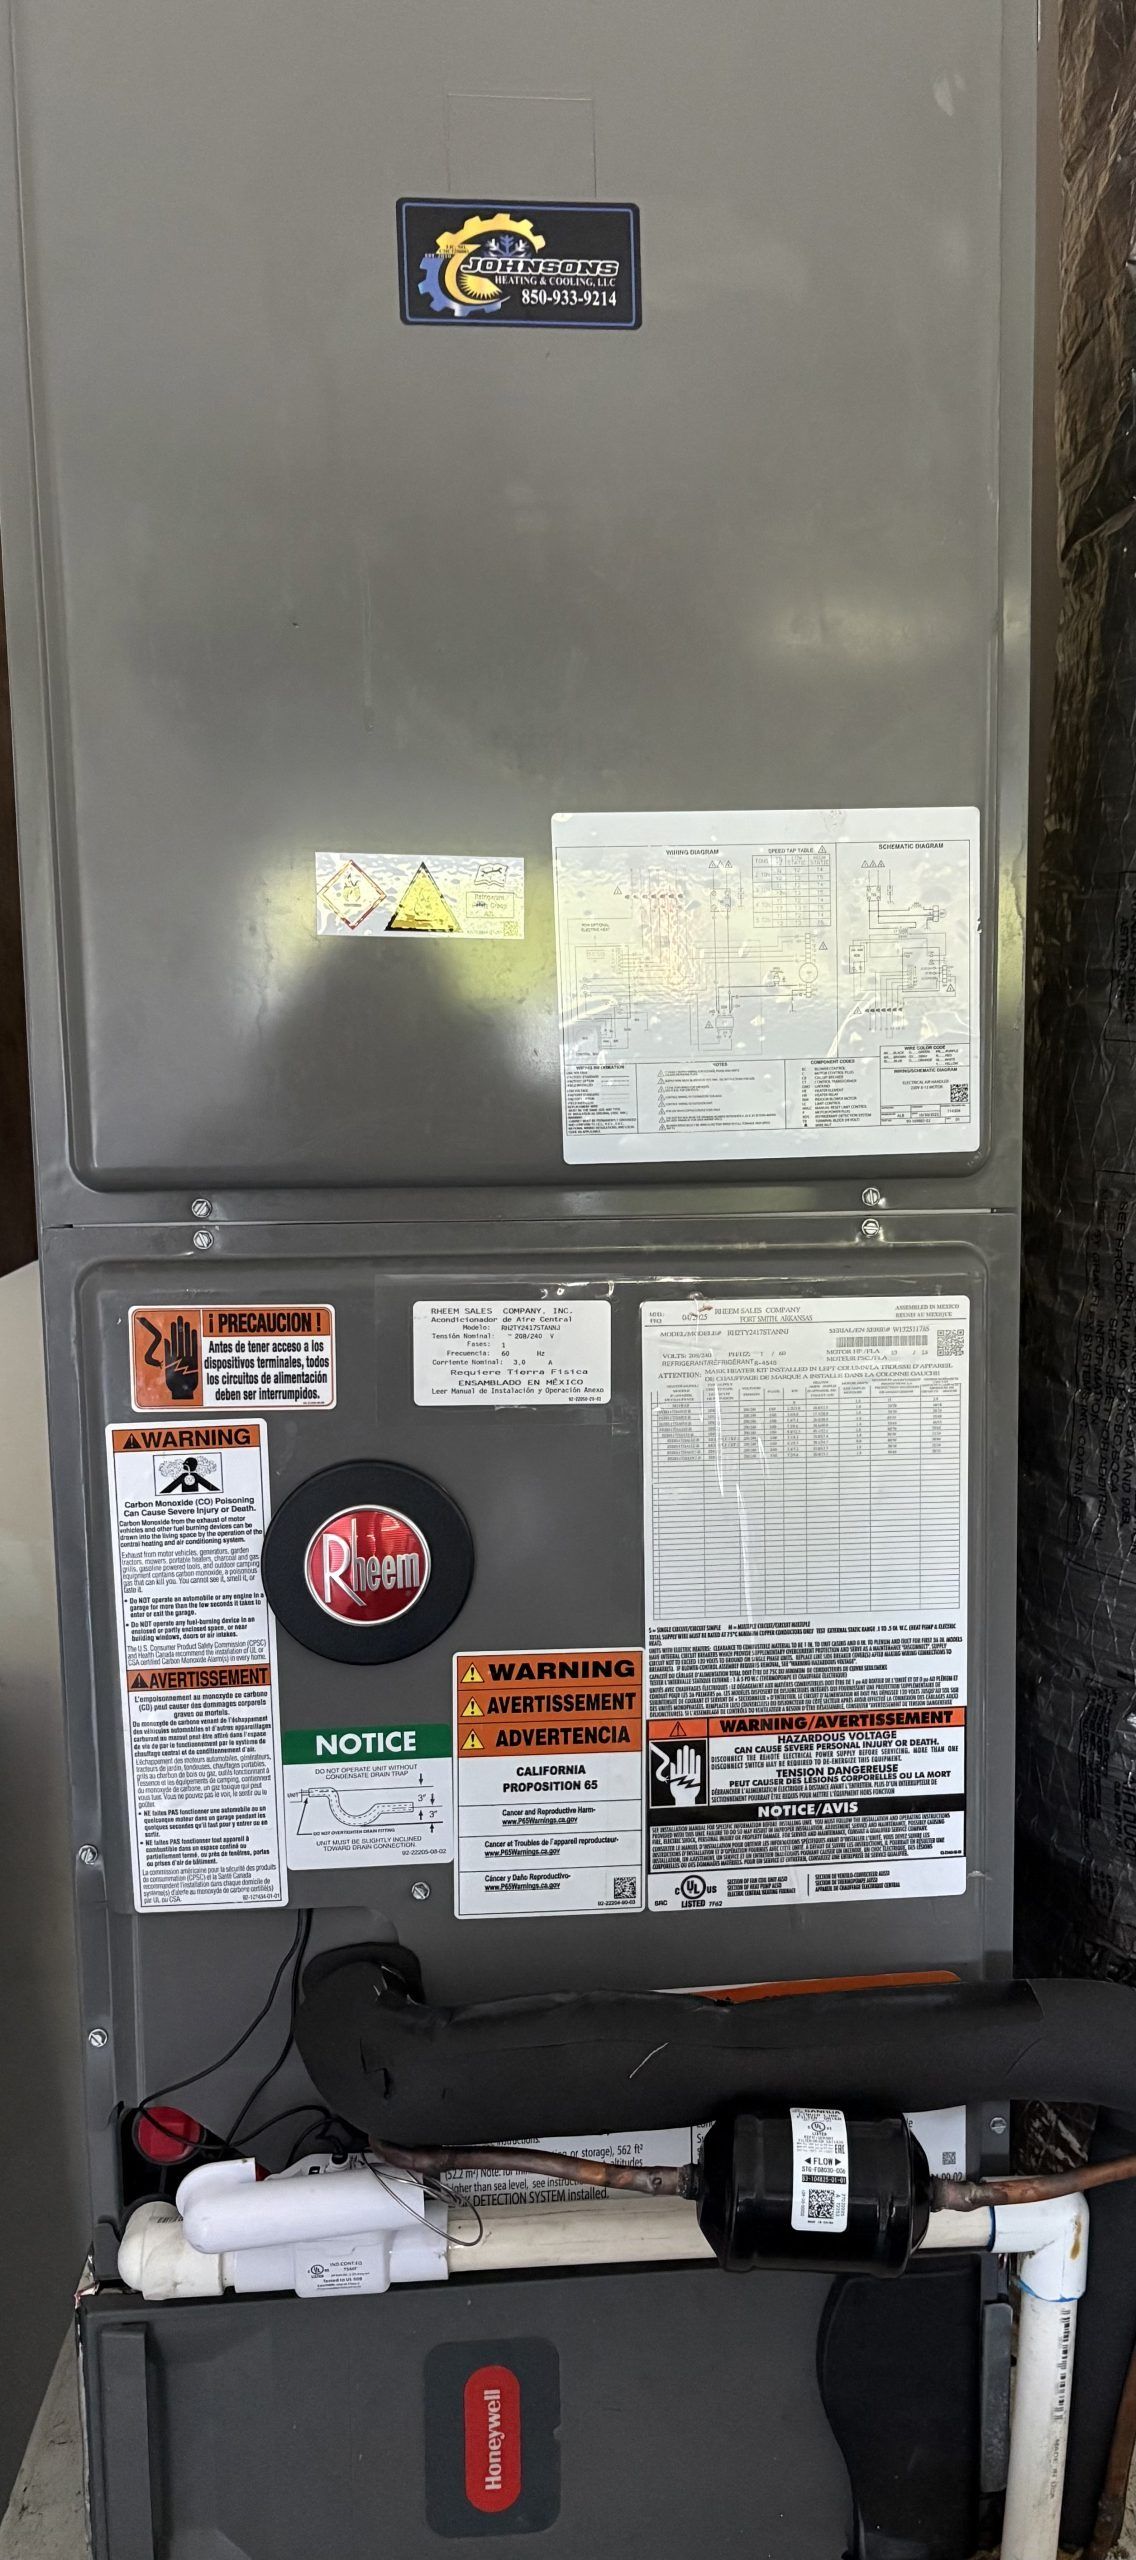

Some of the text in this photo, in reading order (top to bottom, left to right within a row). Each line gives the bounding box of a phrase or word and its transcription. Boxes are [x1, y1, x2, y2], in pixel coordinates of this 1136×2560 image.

[461, 257, 619, 276] JOHNSONS
[495, 276, 616, 287] HEATING & COOLING, LLC
[522, 289, 617, 307] 850-933-9214
[218, 1313, 312, 1333] PRECAUCION
[317, 1314, 321, 1332] !
[209, 1340, 323, 1353] Antes de tener acceso a los
[204, 1357, 329, 1370] dispositivos terminales, todos
[206, 1371, 327, 1385] los circuitos de alimentación
[546, 1378, 583, 1386] MÉXICO
[215, 1388, 320, 1402] deben ser interrumpidos.
[141, 1429, 251, 1448] WARNING
[215, 1497, 254, 1506] Poisoning
[196, 1507, 219, 1516] Injury
[322, 1518, 420, 1606] Rheem
[489, 1660, 635, 1681] WARNING
[150, 1668, 268, 1688] AVERTISSEMENT
[487, 1692, 636, 1714] AVERTISSEMENT
[720, 1710, 953, 1733] WARNING/AVERTISSEMENT
[316, 1731, 416, 1756] NOTICE
[496, 1726, 630, 1747] ADVERTENCIA
[777, 1731, 897, 1744] HAZARDOUS VOLTAGE
[734, 1738, 940, 1755] CAN CAUSE SEVERE PERSONAL INJURY OR DEATH.
[326, 1772, 369, 1780] CONDENSATE
[341, 1766, 370, 1774] OPERATE
[517, 1765, 586, 1776] CALIFORNIA
[776, 1764, 899, 1778] TENSION DANGEREUSE
[503, 1780, 597, 1792] PROPOSITION 65
[729, 1779, 750, 1788] PEUT
[752, 1778, 784, 1787] CAUSER
[786, 1777, 804, 1786] DES
[841, 1772, 898, 1783] CORPORELLES
[900, 1771, 913, 1780] OU
[915, 1771, 925, 1779] LA
[927, 1770, 951, 1779] MORT
[538, 1807, 576, 1815] Reproductive
[758, 1802, 858, 1818] NOTICE/AVIS
[502, 1816, 578, 1826] www.P65Warnings.ca.gov
[485, 1874, 506, 1882] Cáncer
[682, 1900, 705, 1908] LISTED
[581, 2146, 614, 2158] storage),
[617, 2144, 631, 2155] 562
[814, 2158, 833, 2166] FLOW
[474, 2178, 546, 2192] than sea level, see
[473, 2187, 610, 2206] DETECTION SYSTEM installed.
[483, 2389, 505, 2491] Honeywell
